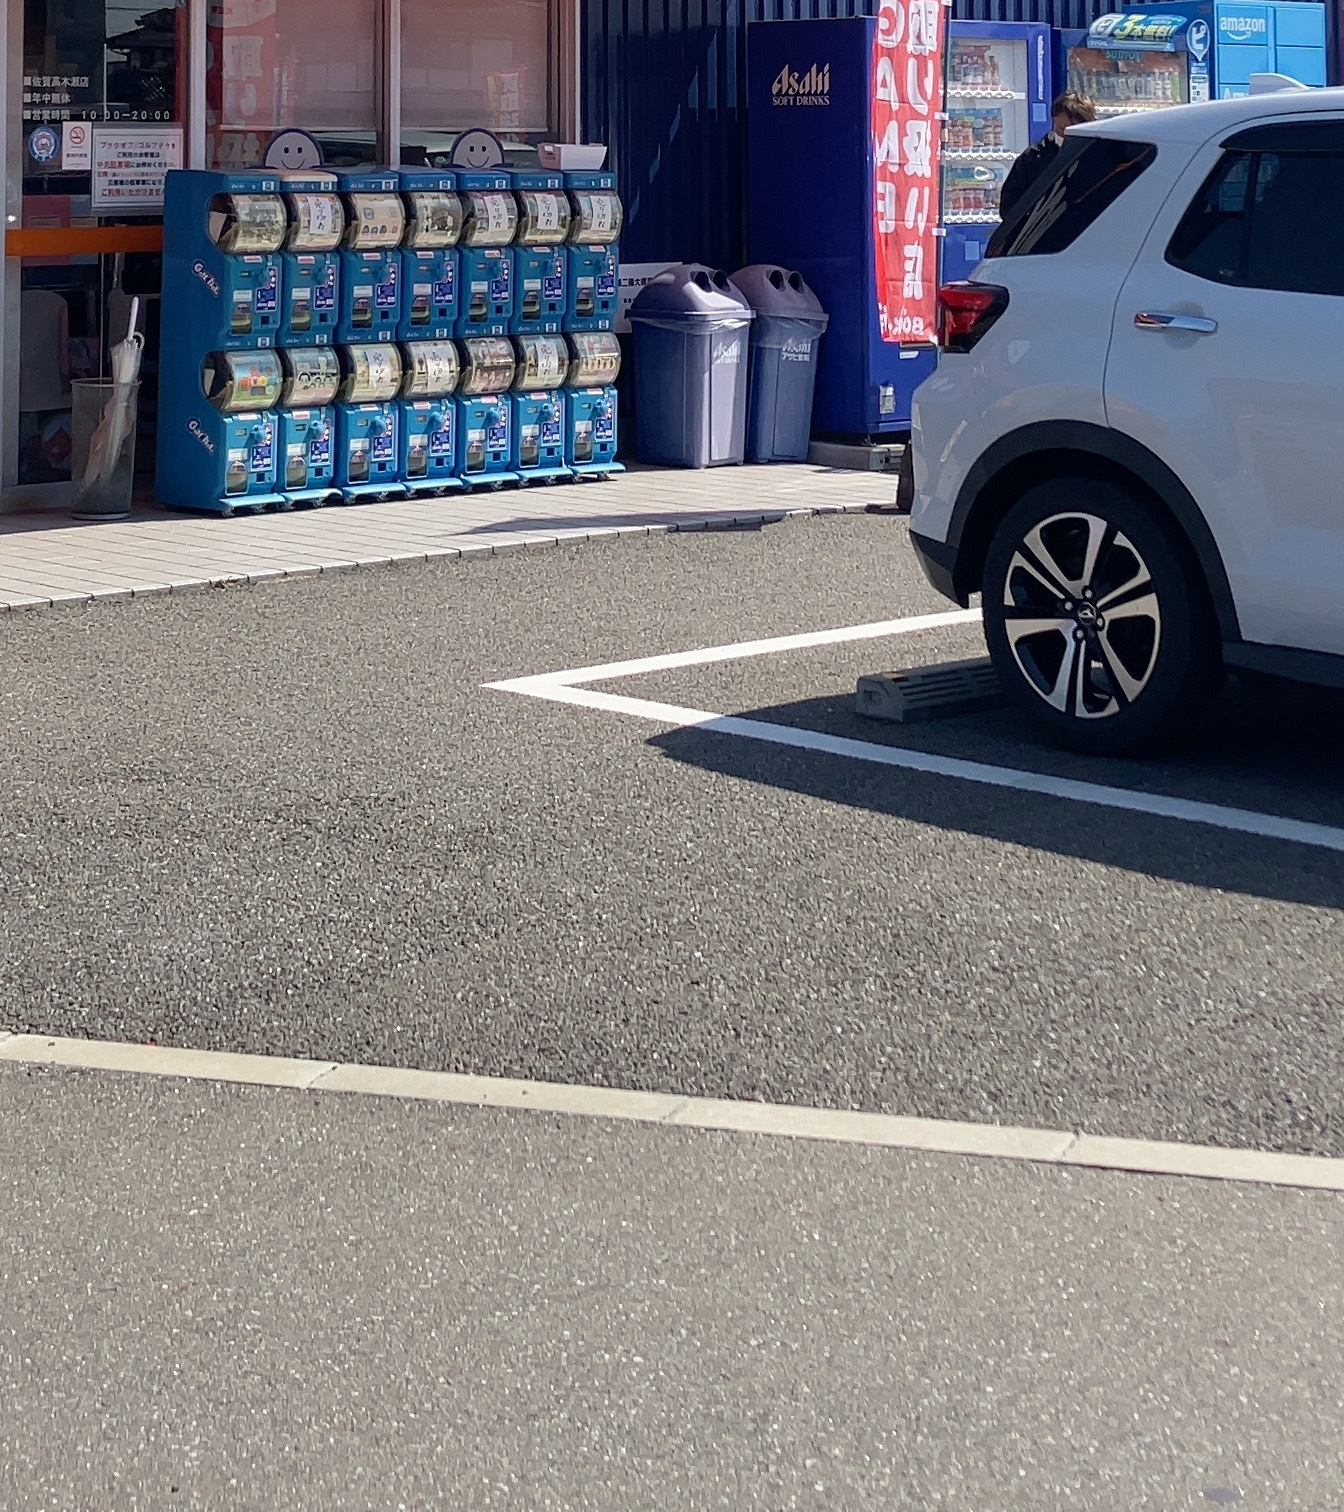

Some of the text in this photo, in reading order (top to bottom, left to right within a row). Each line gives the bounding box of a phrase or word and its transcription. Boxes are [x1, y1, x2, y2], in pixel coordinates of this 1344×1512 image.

[1220, 16, 1266, 33] amazon
[771, 62, 830, 95] Asahi
[773, 95, 830, 106] SOFT DRINKS
